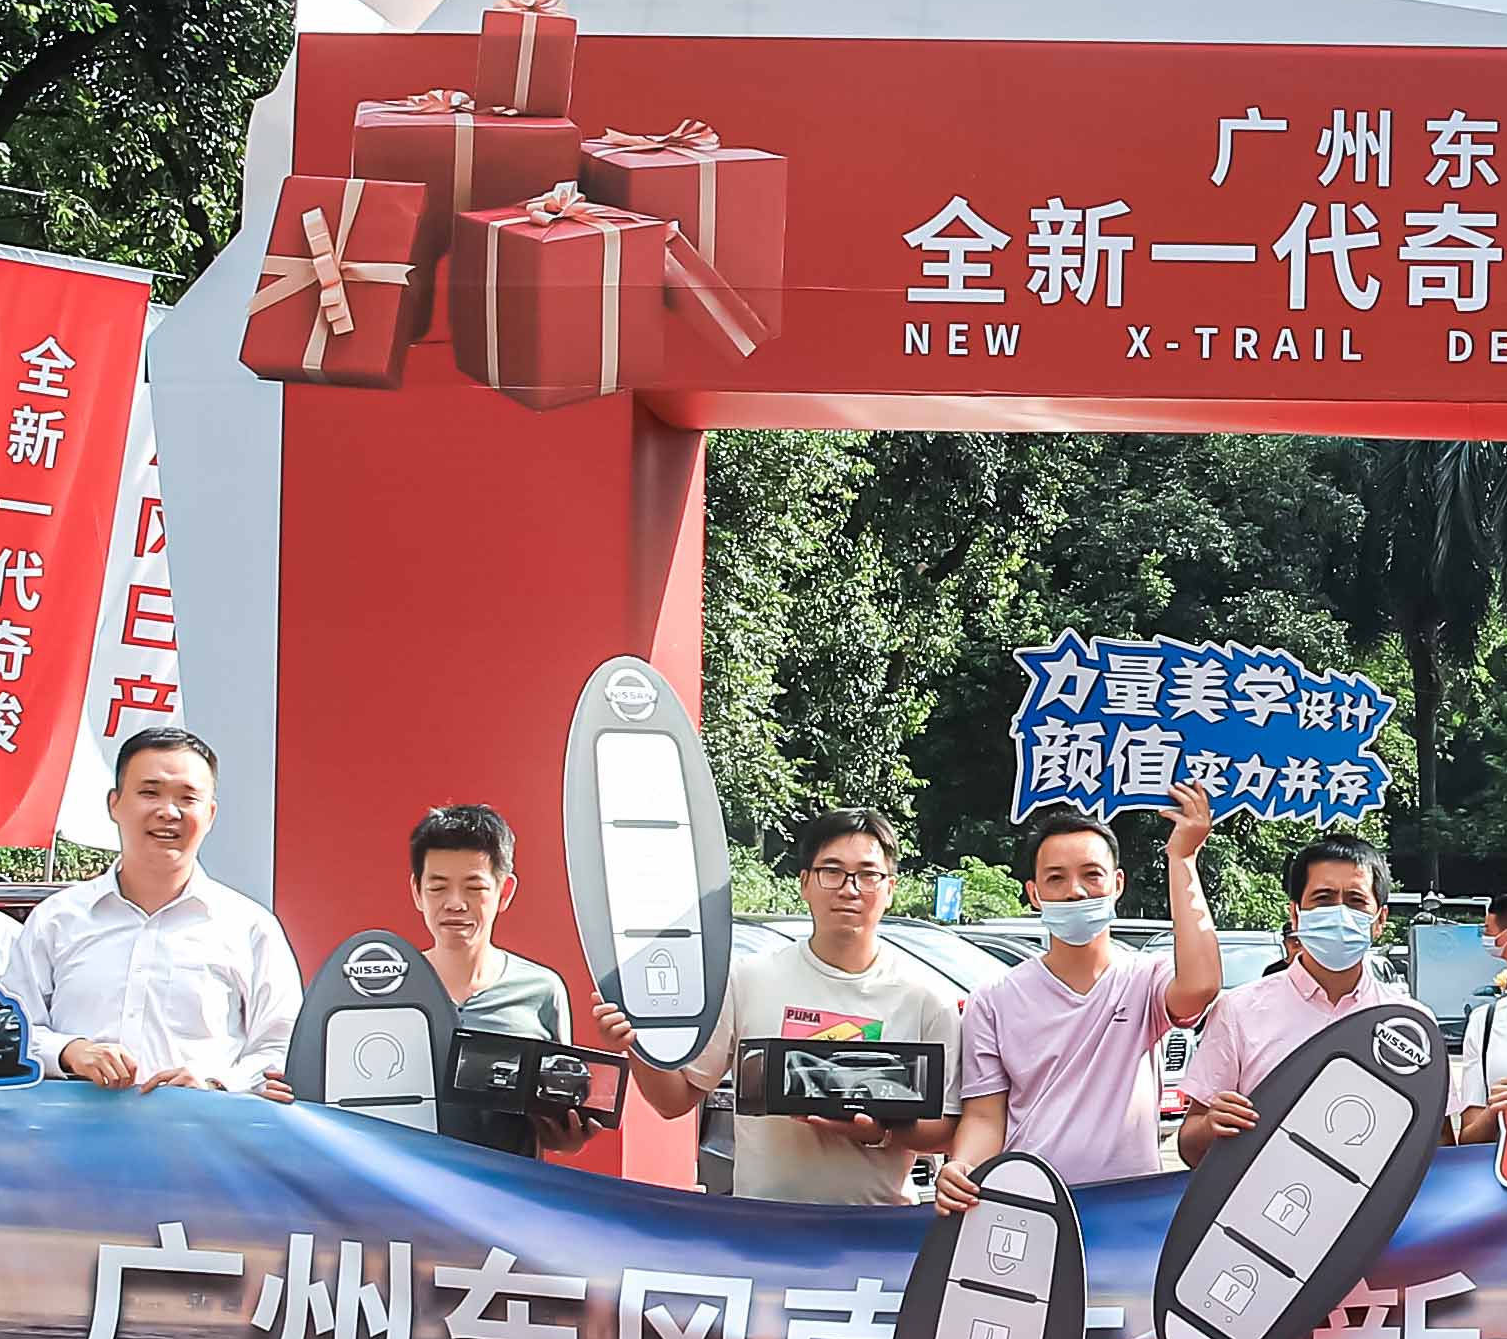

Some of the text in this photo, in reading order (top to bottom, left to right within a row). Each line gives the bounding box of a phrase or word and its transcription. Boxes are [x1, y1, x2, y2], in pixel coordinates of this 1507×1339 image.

[904, 321, 1022, 357] NEW
[1125, 325, 1366, 363] X-TRAIL
[1038, 647, 1377, 734] 力量美学设计
[1030, 718, 1372, 806] 颜值实力并存
[348, 963, 402, 975] NISSAN
[786, 1009, 822, 1024] PUMA
[1378, 1028, 1424, 1064] NISSAN
